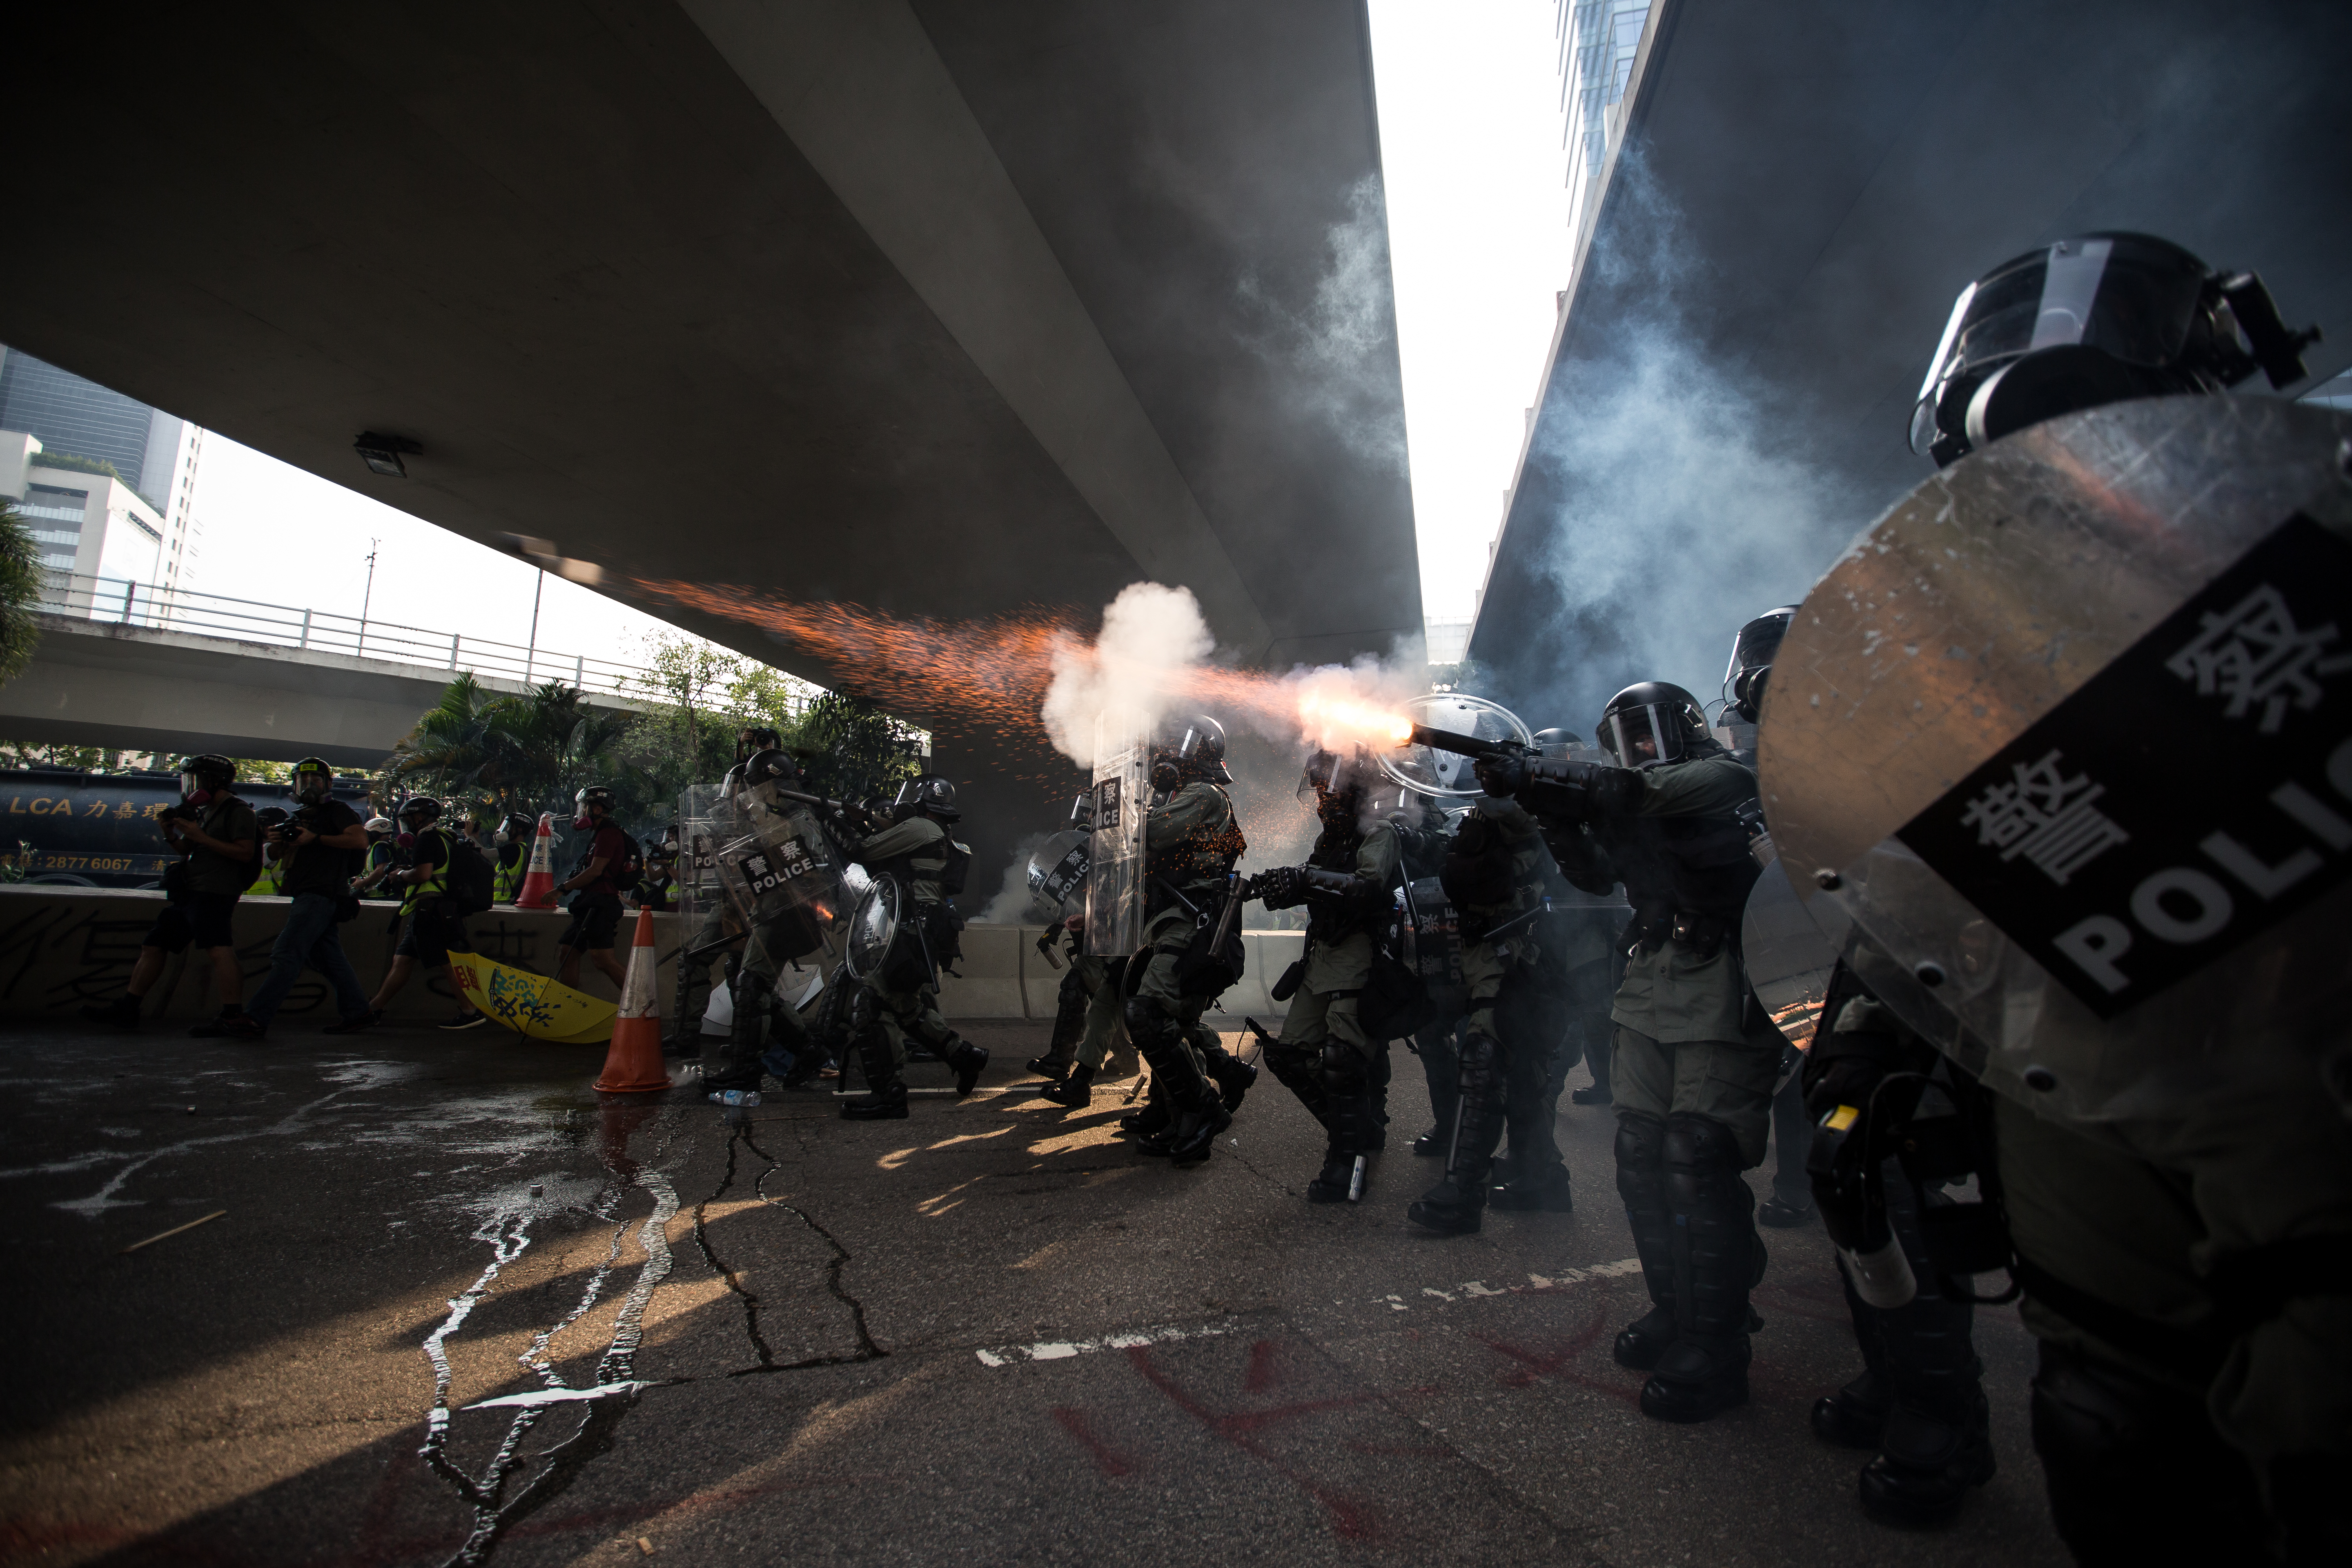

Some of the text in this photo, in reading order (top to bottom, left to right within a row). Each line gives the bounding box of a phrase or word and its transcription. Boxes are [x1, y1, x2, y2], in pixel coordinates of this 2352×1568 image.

[1604, 706, 1619, 719] olice
[1961, 582, 2352, 887] 警察
[9, 797, 72, 815] LCA
[1090, 809, 1118, 831] POICE
[747, 840, 802, 876] 警察
[752, 858, 813, 893] POLICE
[1047, 850, 1084, 889] 警察
[2051, 735, 2352, 995] POLI
[1057, 859, 1089, 901] POLIC
[1419, 913, 1443, 976] 警察
[1444, 907, 1462, 980] POLICE
